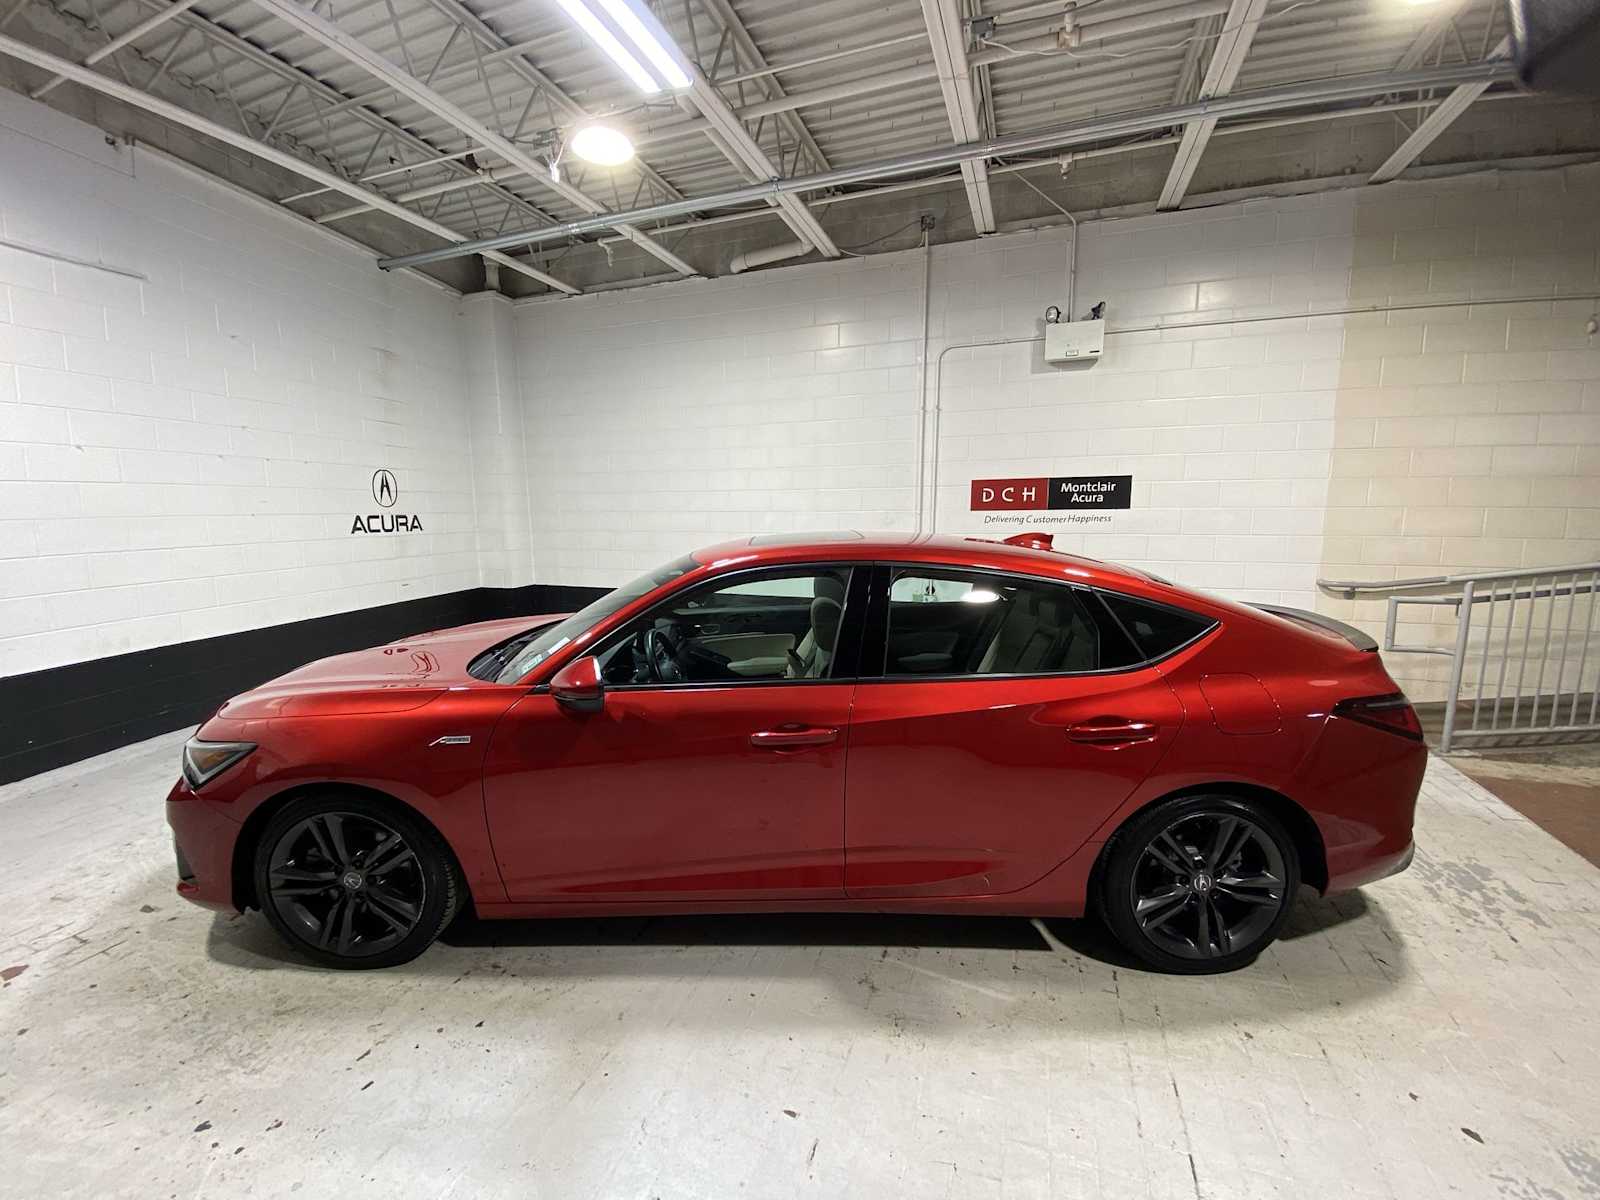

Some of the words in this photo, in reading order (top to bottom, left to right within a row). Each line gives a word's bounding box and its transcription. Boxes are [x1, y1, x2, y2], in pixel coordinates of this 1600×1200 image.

[1060, 482, 1116, 493] Montclair
[1070, 493, 1104, 503] Acura
[351, 515, 423, 534] ACURA
[984, 514, 1025, 525] Delivering
[1067, 514, 1112, 524] Happiness
